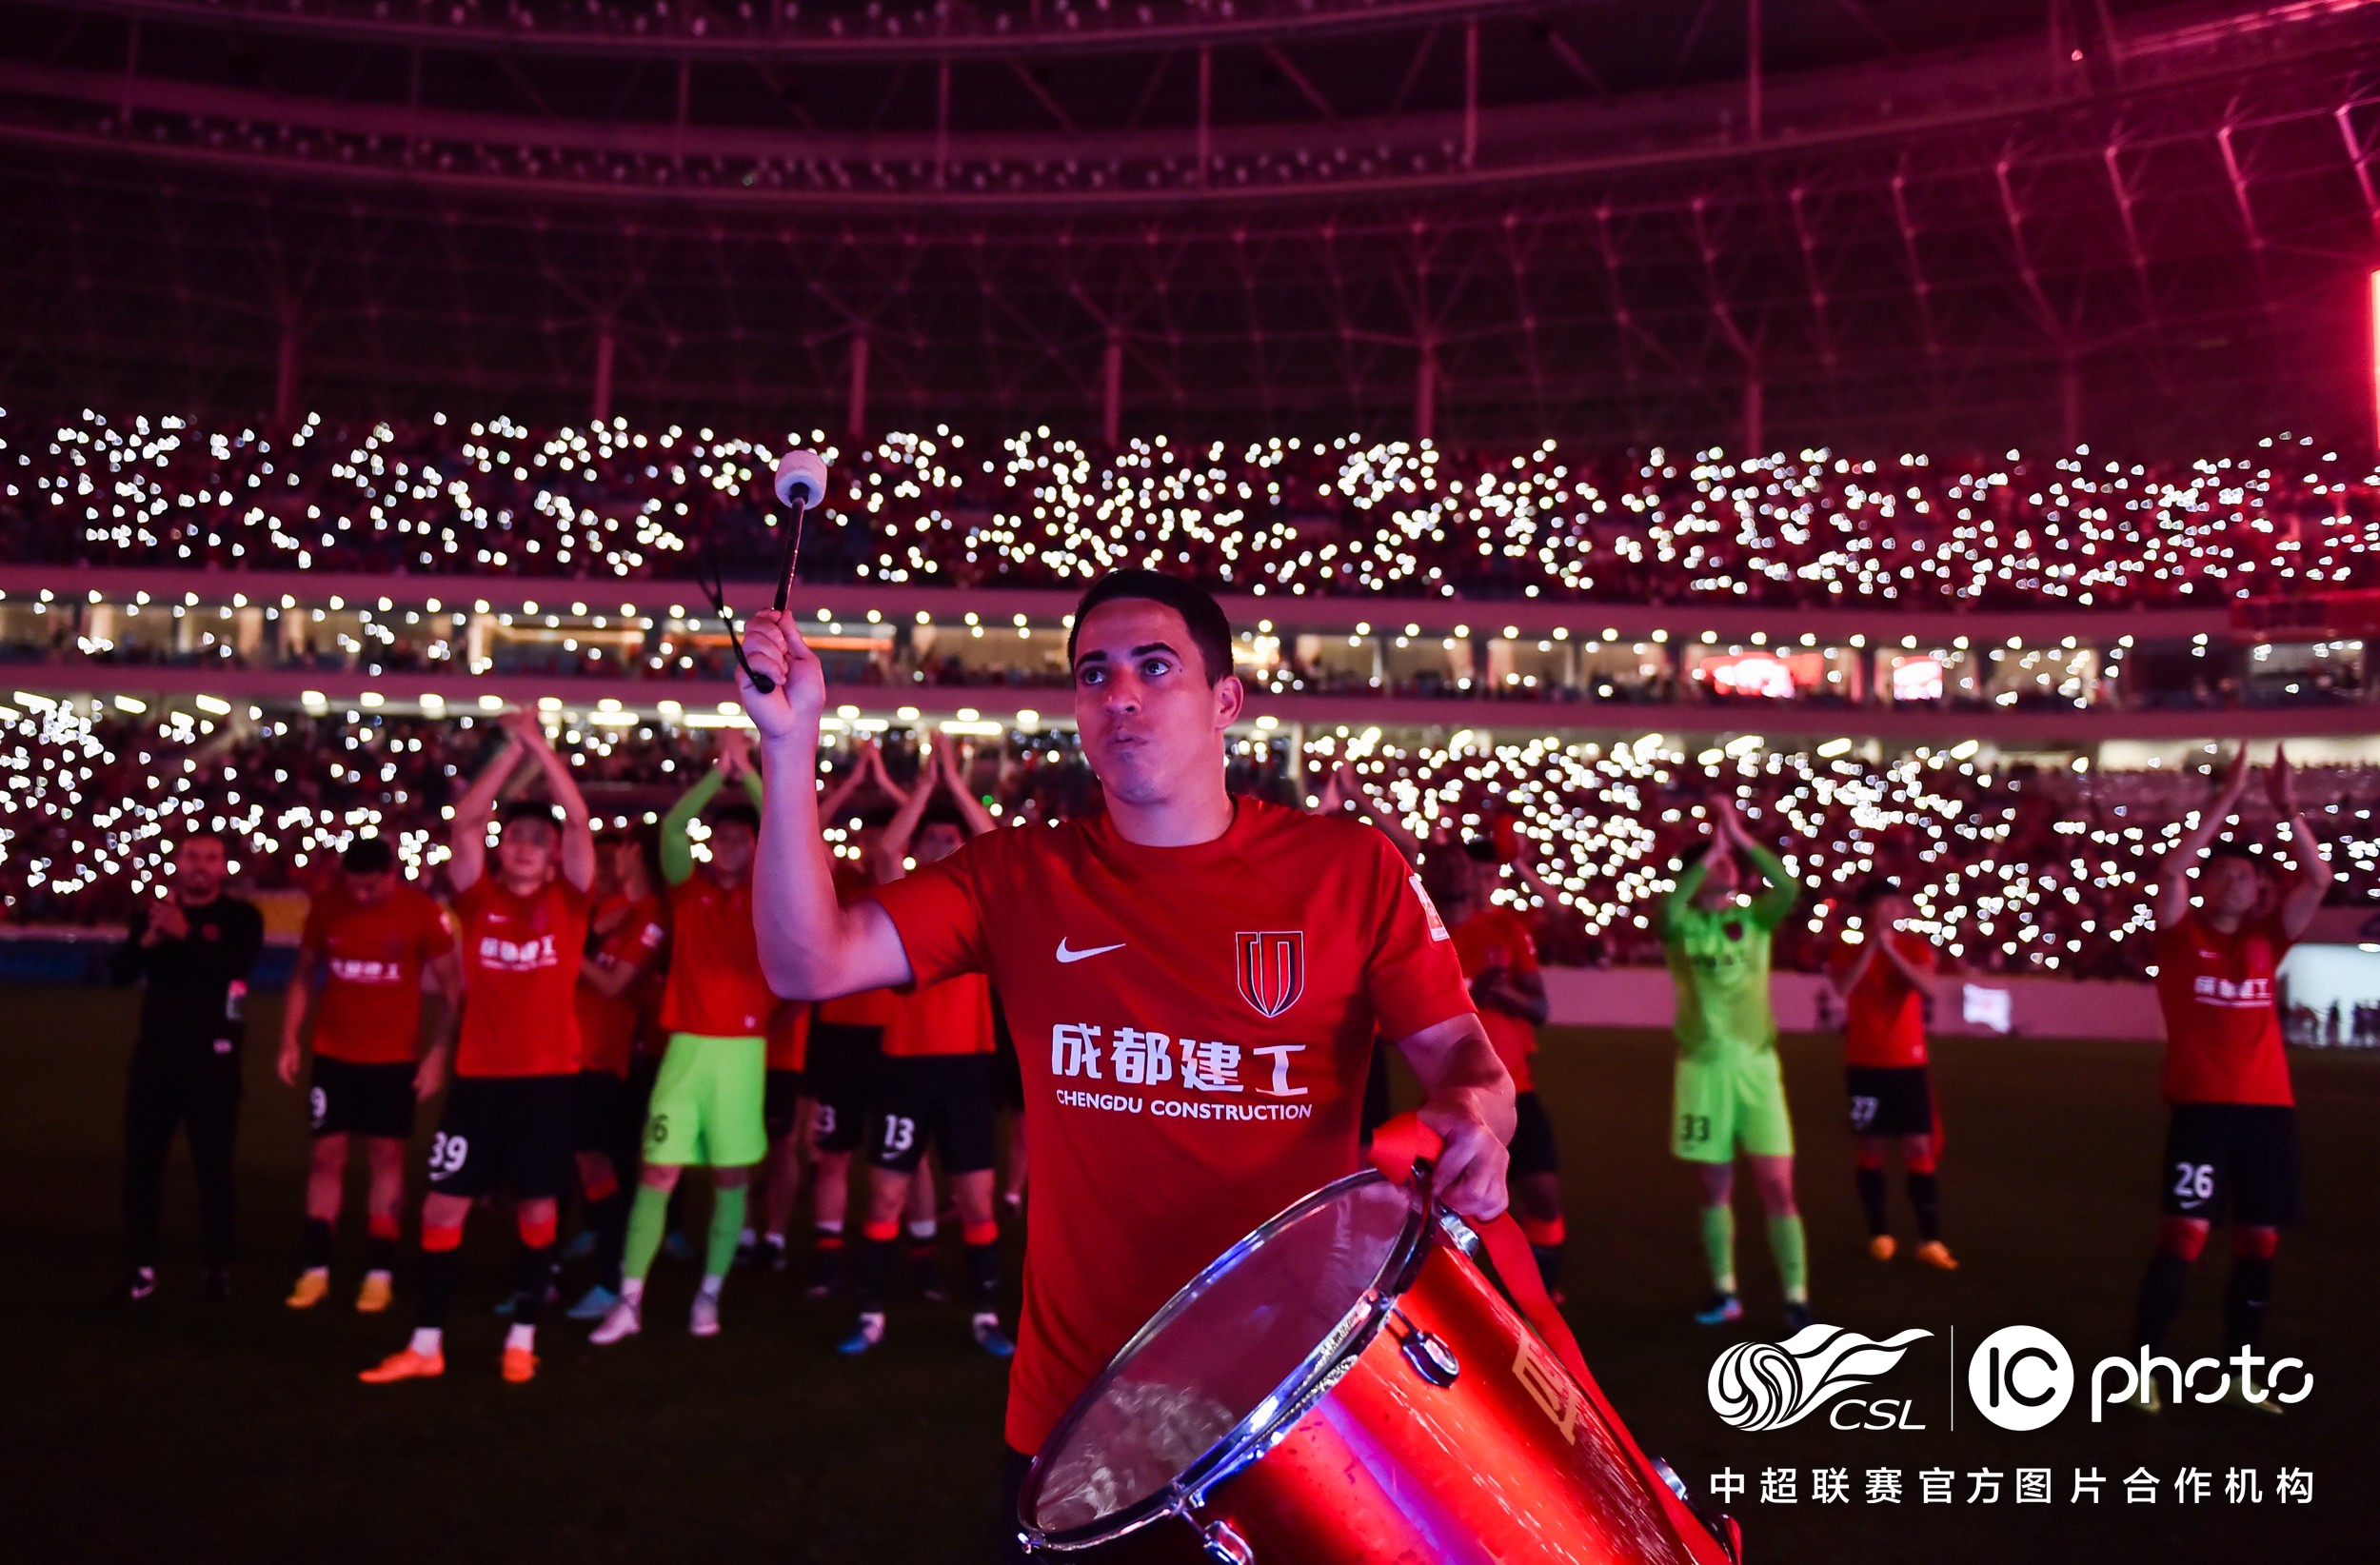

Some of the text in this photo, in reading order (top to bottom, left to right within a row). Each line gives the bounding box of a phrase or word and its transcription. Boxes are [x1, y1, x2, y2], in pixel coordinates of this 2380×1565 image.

[1051, 1022, 1309, 1098] 成都建工
[1056, 1089, 1313, 1121] CHENGDU CONSTRUCTION
[884, 1114, 915, 1152] 13
[1681, 1114, 1711, 1141] 33
[428, 1130, 468, 1172] 39
[2172, 1160, 2215, 1199] 26
